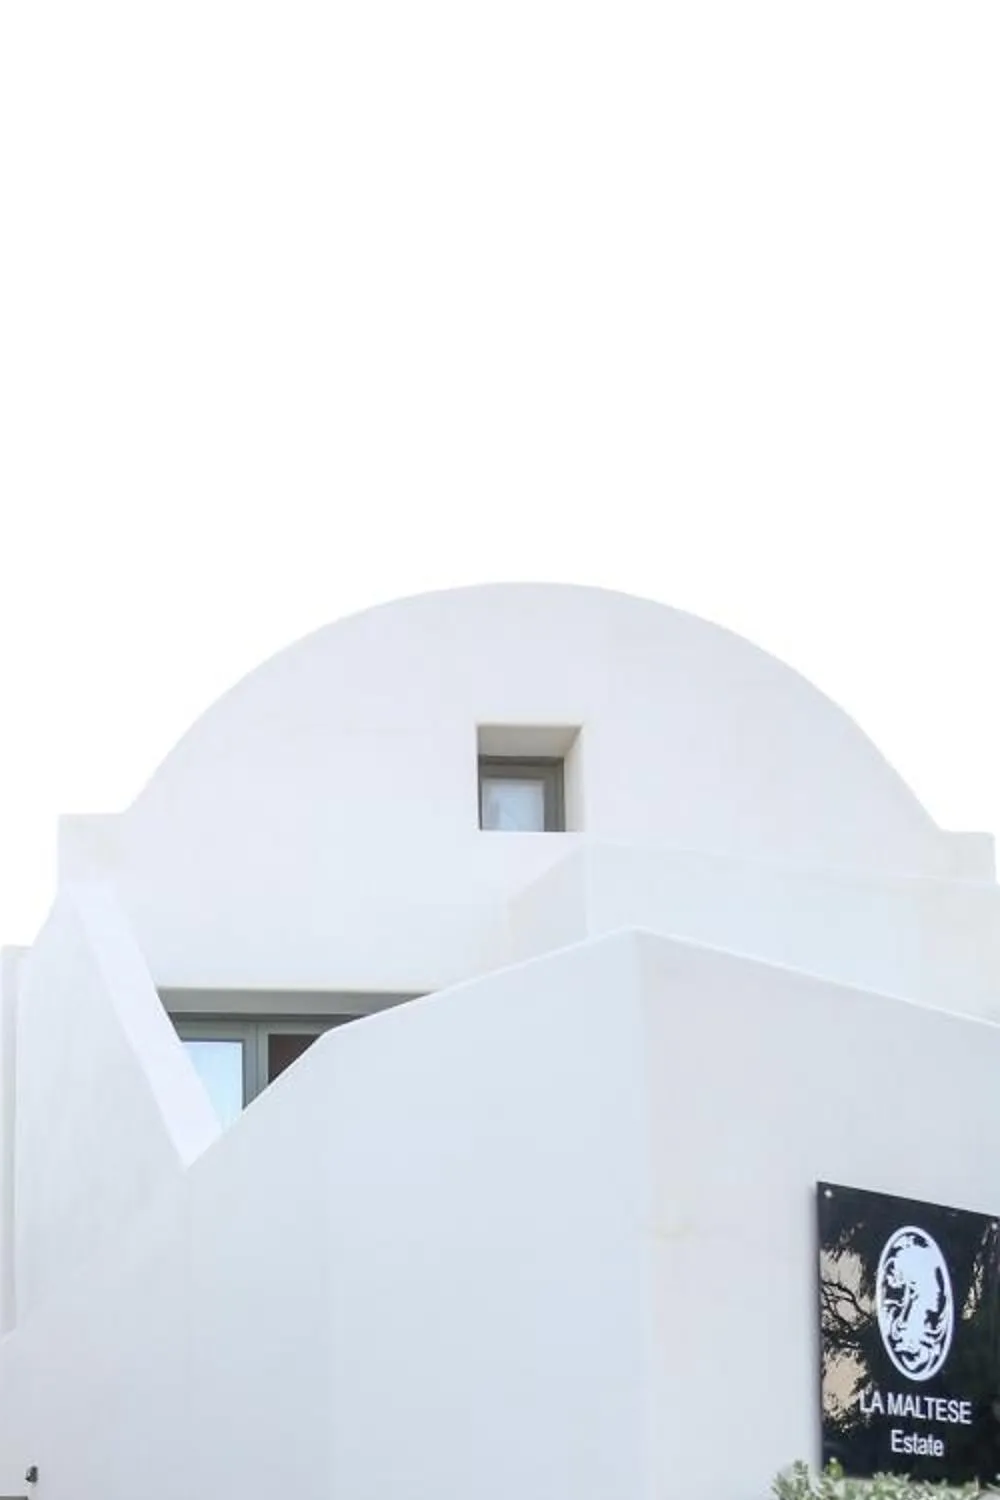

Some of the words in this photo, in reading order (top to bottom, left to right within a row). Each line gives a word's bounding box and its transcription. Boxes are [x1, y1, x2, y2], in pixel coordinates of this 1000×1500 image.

[859, 1389, 885, 1415] LA
[887, 1391, 972, 1425] MALTESE
[891, 1429, 944, 1457] Estate
